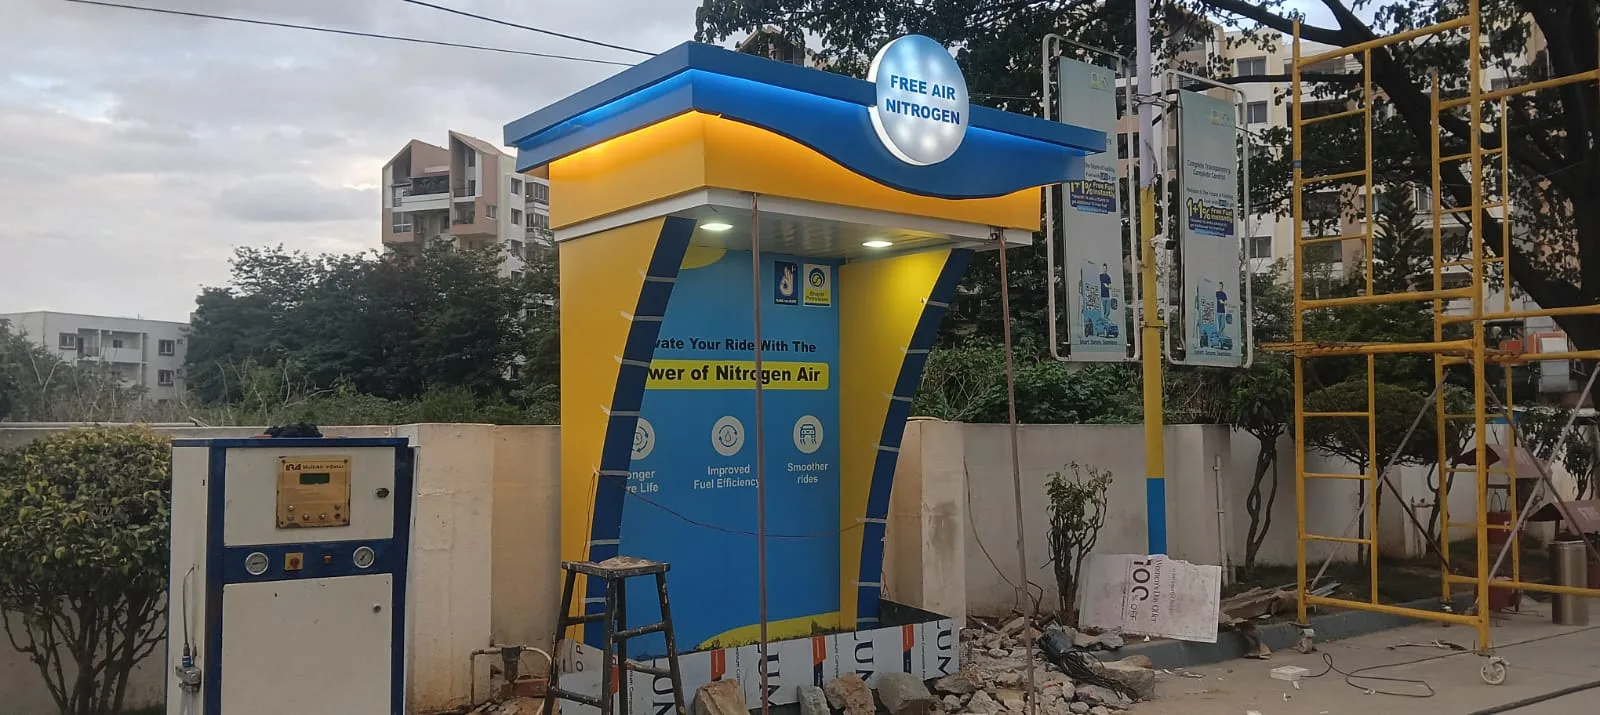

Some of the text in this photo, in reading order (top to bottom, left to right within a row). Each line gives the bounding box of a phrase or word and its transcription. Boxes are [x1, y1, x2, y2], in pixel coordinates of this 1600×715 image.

[890, 74, 956, 101] FREE AIR
[886, 98, 961, 125] NITROGEN
[655, 338, 816, 353] vate Your Ride With The
[649, 367, 685, 381] wer
[690, 365, 709, 381] of
[796, 367, 821, 382] Air
[707, 464, 750, 477] Improved
[787, 462, 828, 473] Smoother
[627, 469, 656, 481] onger
[797, 475, 818, 484] rides
[626, 482, 659, 493] re Life
[694, 478, 760, 490] Fuel Efficiency
